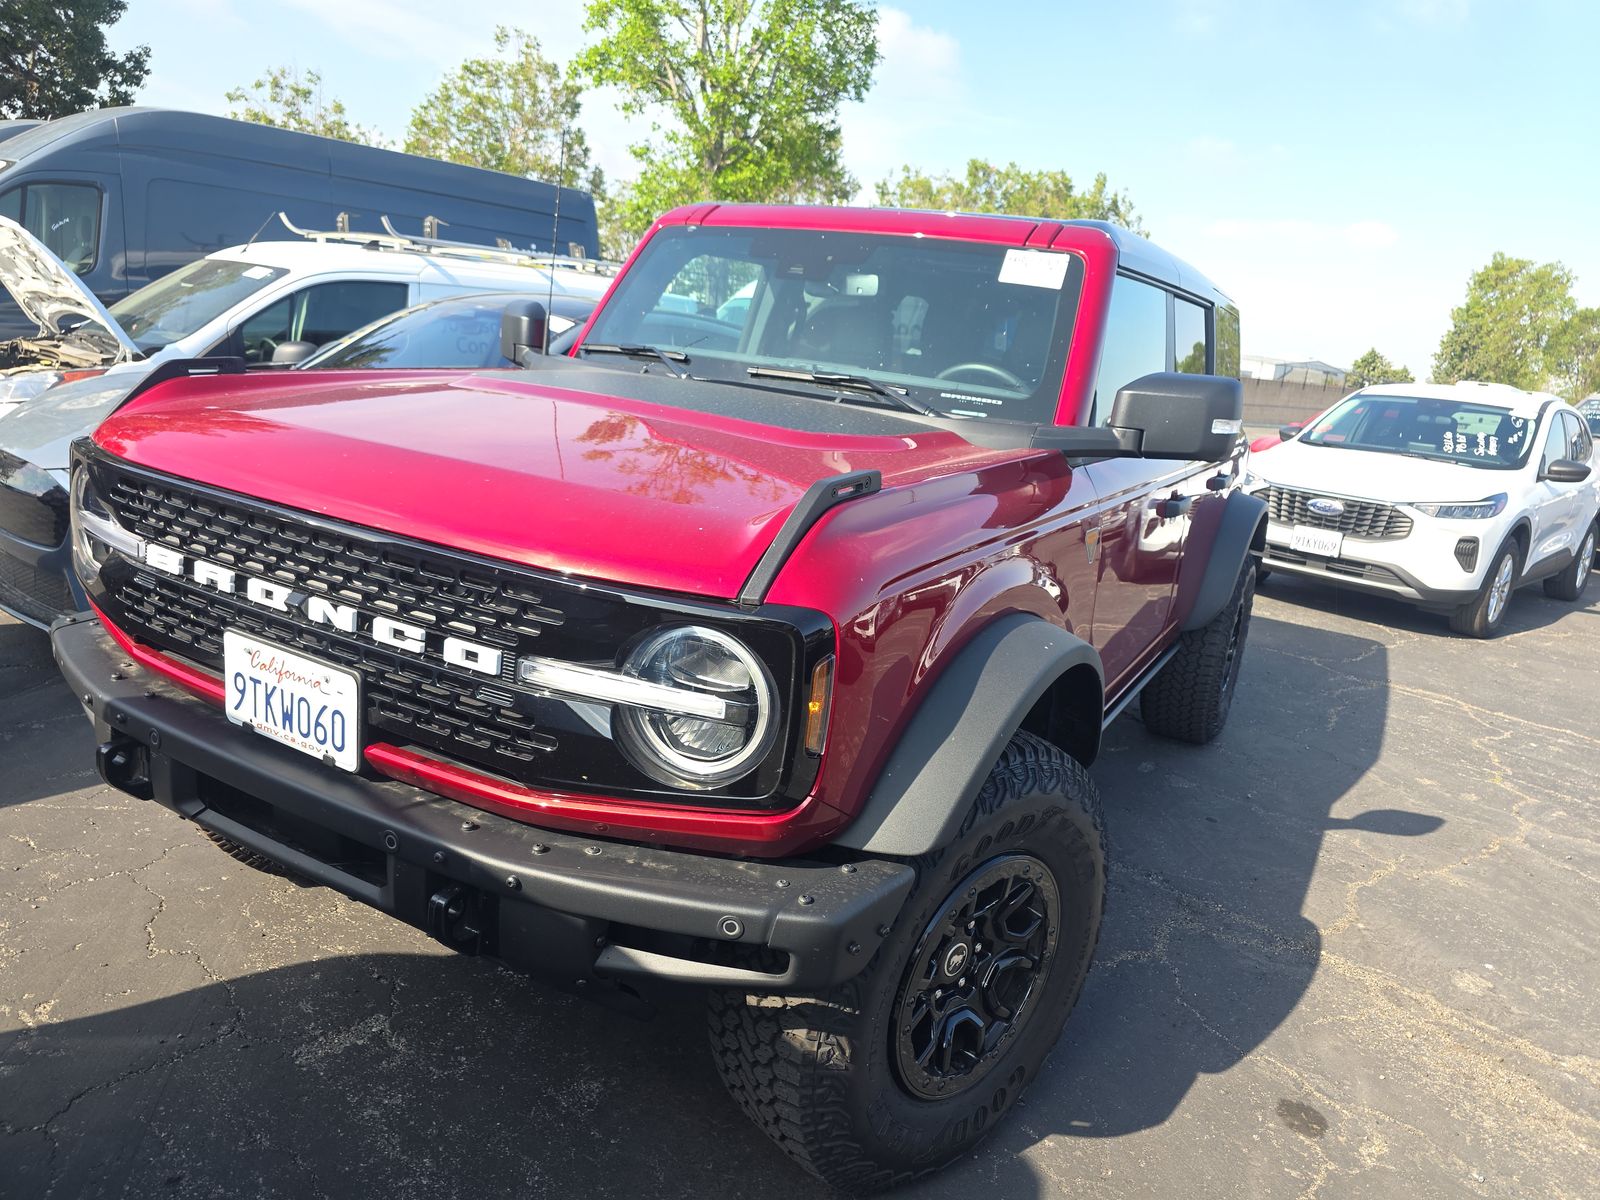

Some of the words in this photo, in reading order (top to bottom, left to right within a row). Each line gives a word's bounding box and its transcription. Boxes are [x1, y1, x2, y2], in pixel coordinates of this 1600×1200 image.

[147, 543, 502, 676] BRONCO
[250, 650, 331, 696] California
[234, 671, 345, 753] 9TKW060
[256, 722, 322, 754] dmv.ca.gov
